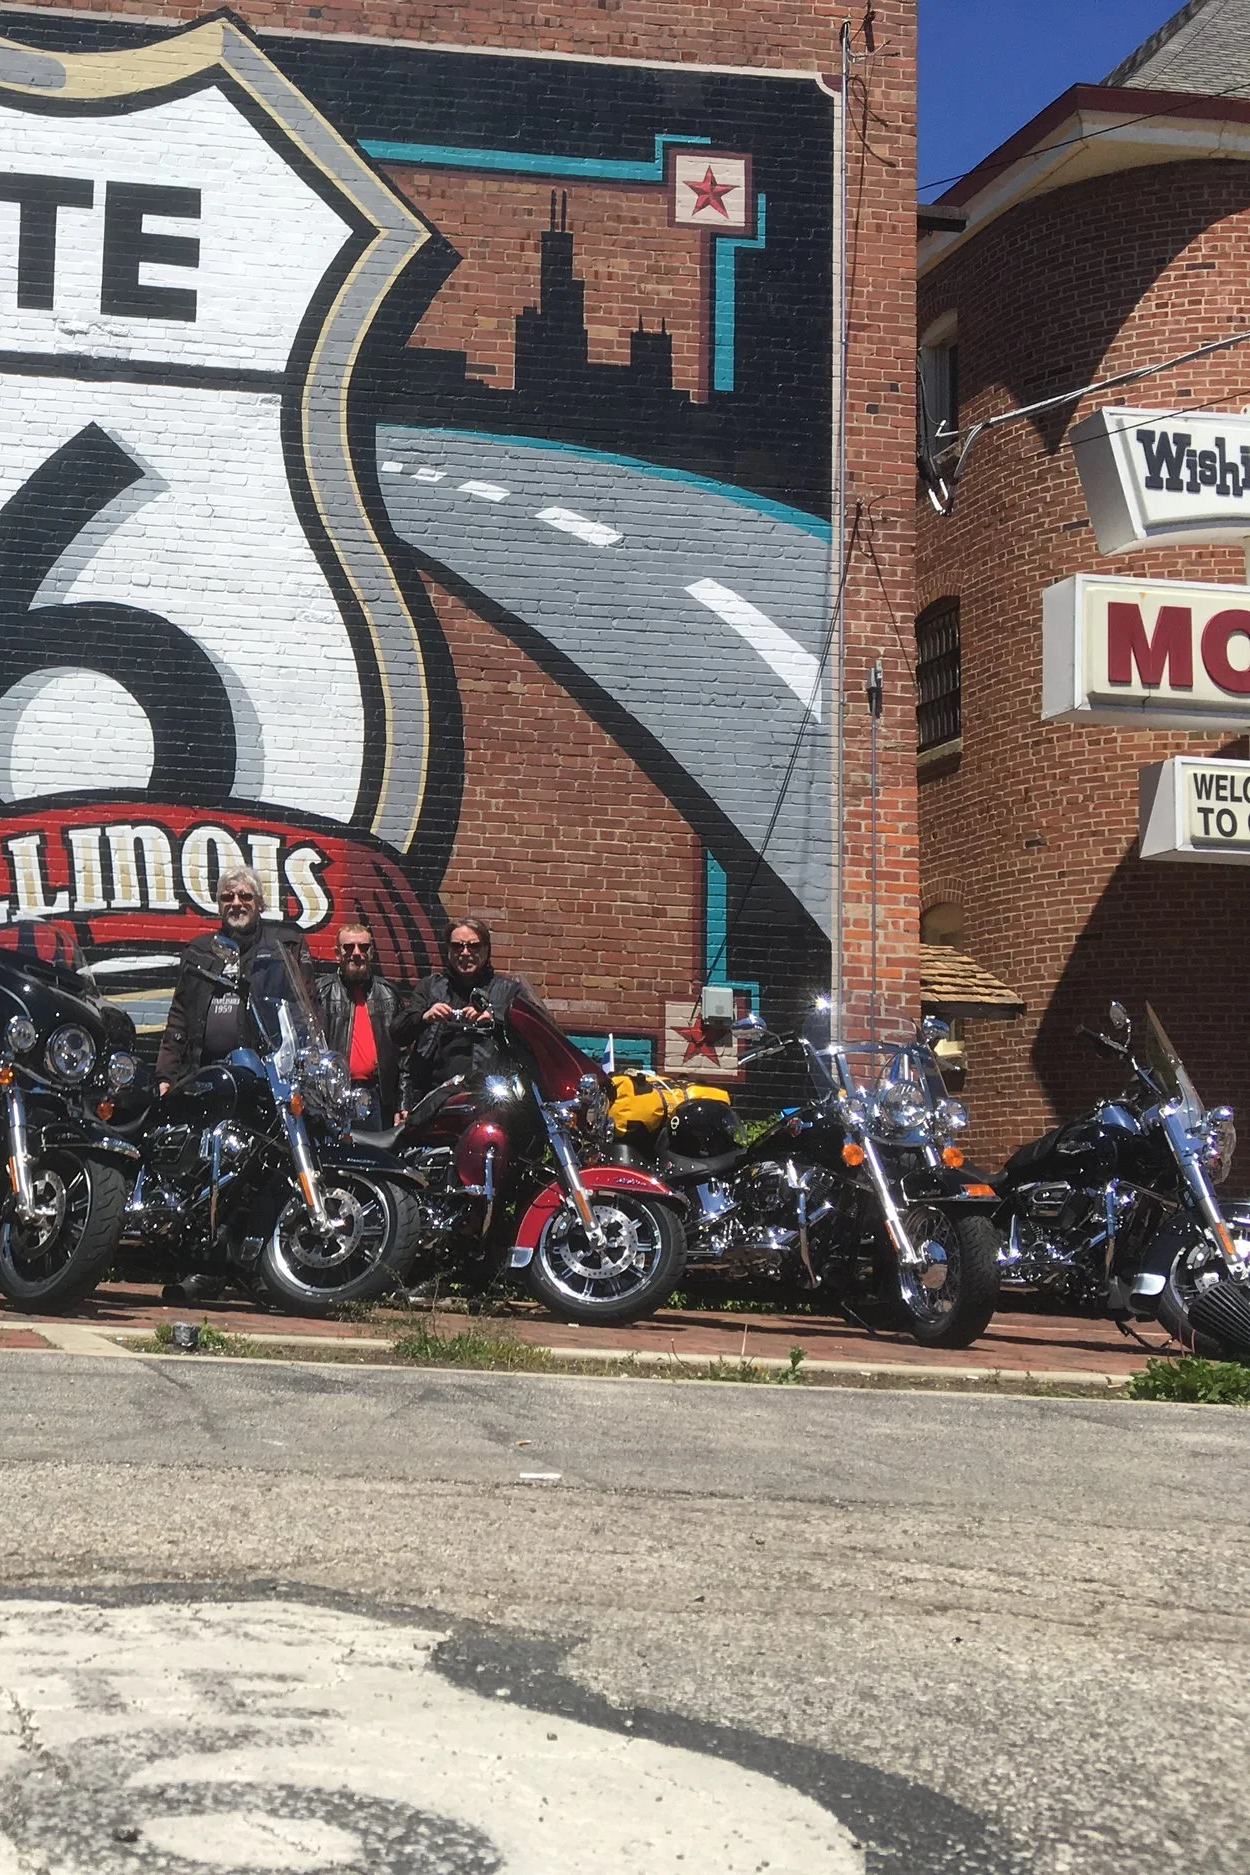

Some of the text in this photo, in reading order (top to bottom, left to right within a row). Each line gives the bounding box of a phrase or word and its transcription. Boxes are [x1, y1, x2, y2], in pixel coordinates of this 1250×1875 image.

[1136, 428, 1250, 497] Wishi
[1107, 601, 1250, 697] MO
[1197, 806, 1238, 838] TO
